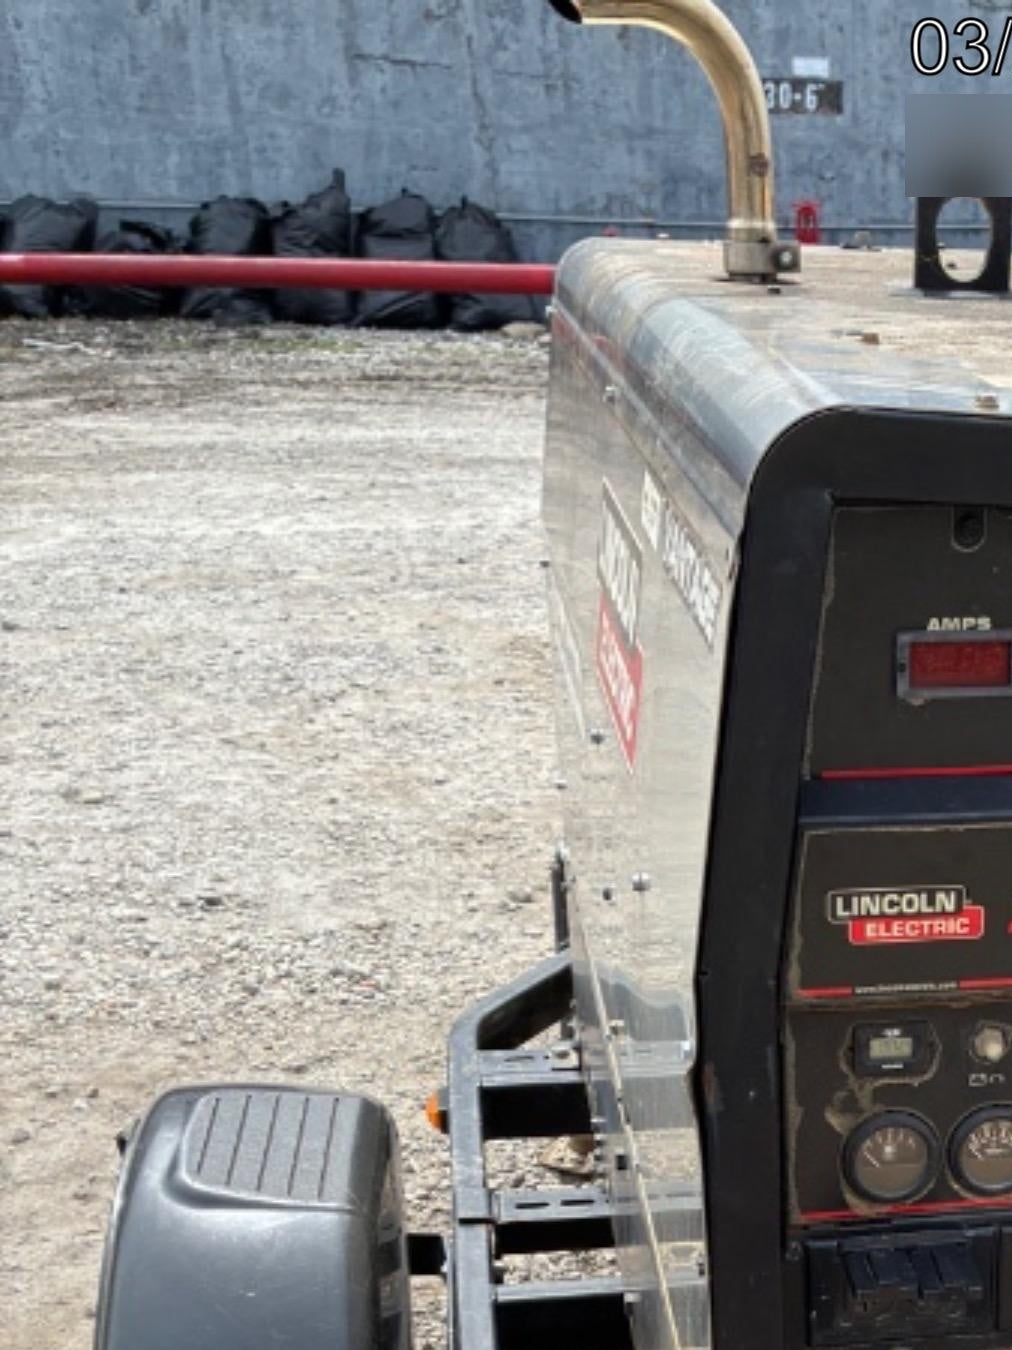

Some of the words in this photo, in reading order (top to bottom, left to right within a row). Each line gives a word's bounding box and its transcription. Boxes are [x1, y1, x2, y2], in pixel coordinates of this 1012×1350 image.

[926, 616, 992, 632] AMPS
[835, 890, 957, 917] LINCOLN
[864, 917, 971, 938] ELECTRIC
